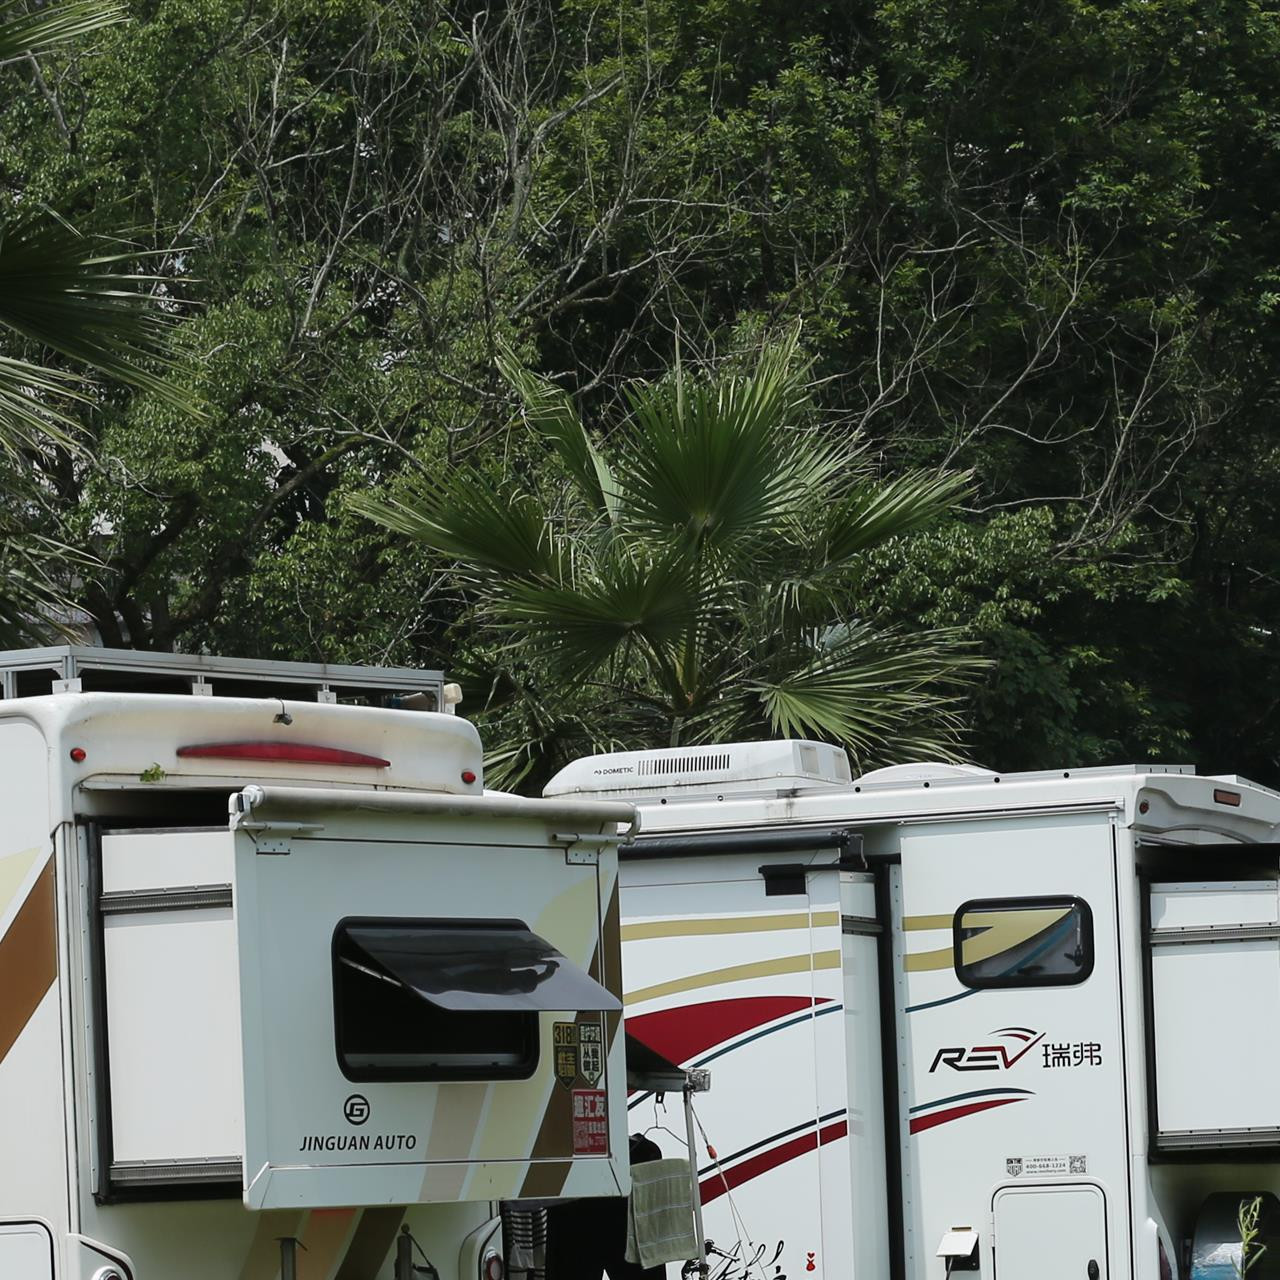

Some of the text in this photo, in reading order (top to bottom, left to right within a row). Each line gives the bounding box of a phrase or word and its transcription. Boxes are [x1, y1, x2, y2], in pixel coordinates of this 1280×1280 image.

[602, 766, 634, 775] DOMETIC
[928, 1031, 1047, 1073] REV
[1041, 1041, 1103, 1069] 瑞弗
[300, 1135, 417, 1151] JINGUAN AUTO
